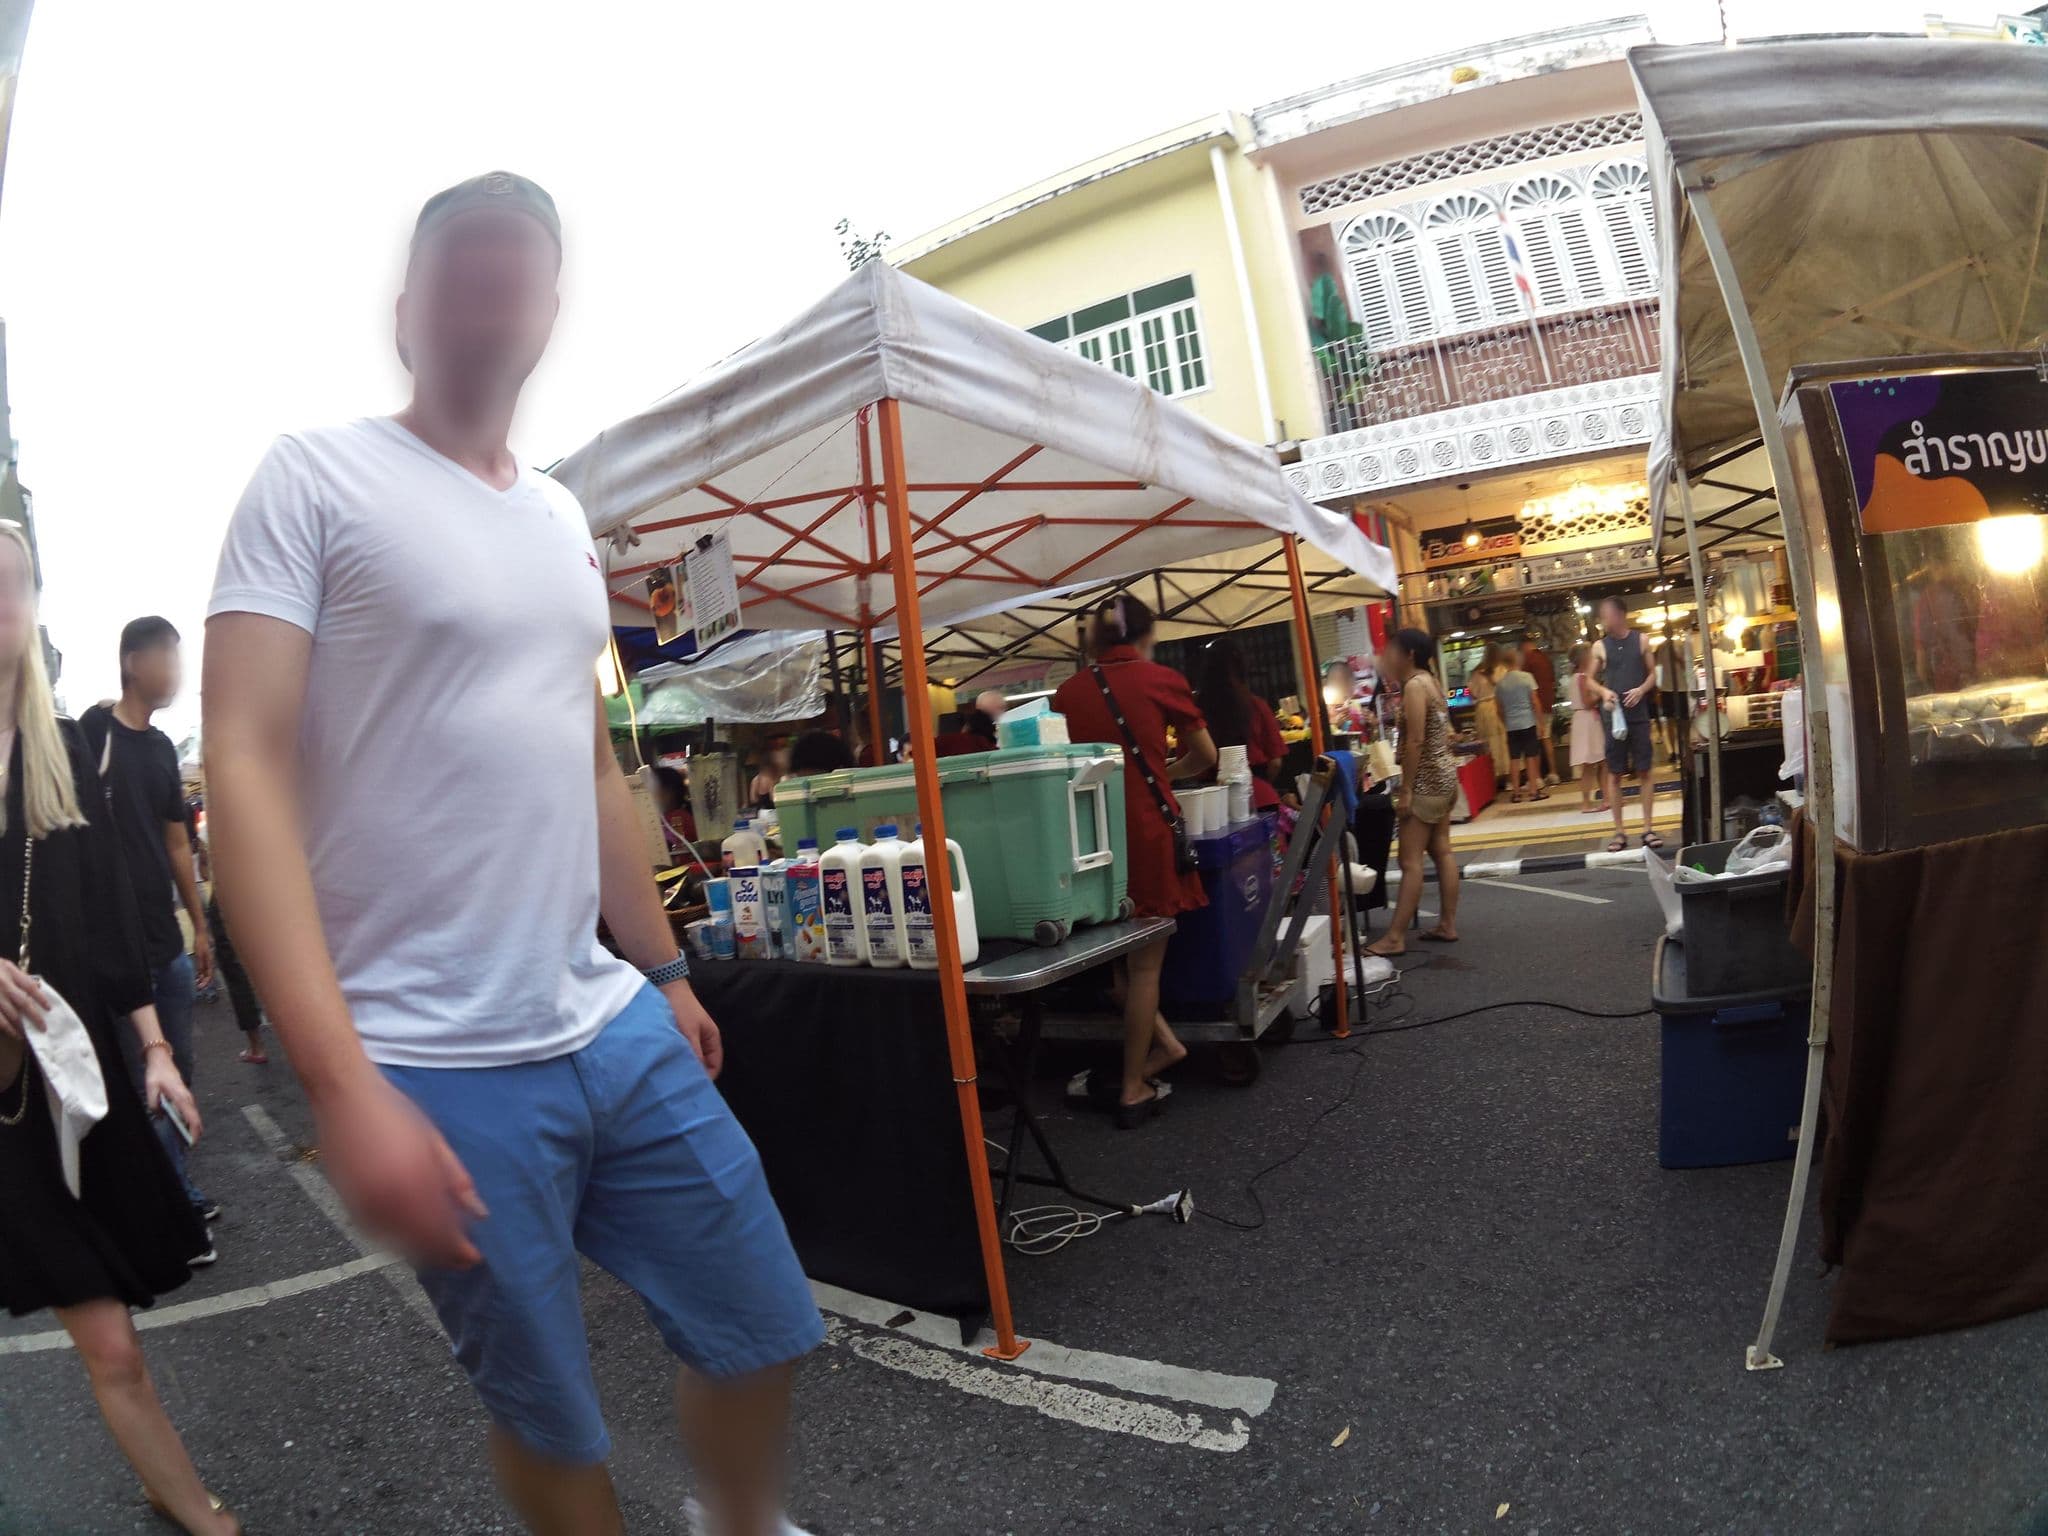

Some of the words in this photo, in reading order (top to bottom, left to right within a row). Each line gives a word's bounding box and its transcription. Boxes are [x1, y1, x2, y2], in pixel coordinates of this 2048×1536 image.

[1902, 420, 2048, 475] สำราญข
[740, 880, 754, 893] So
[735, 891, 758, 903] Good
